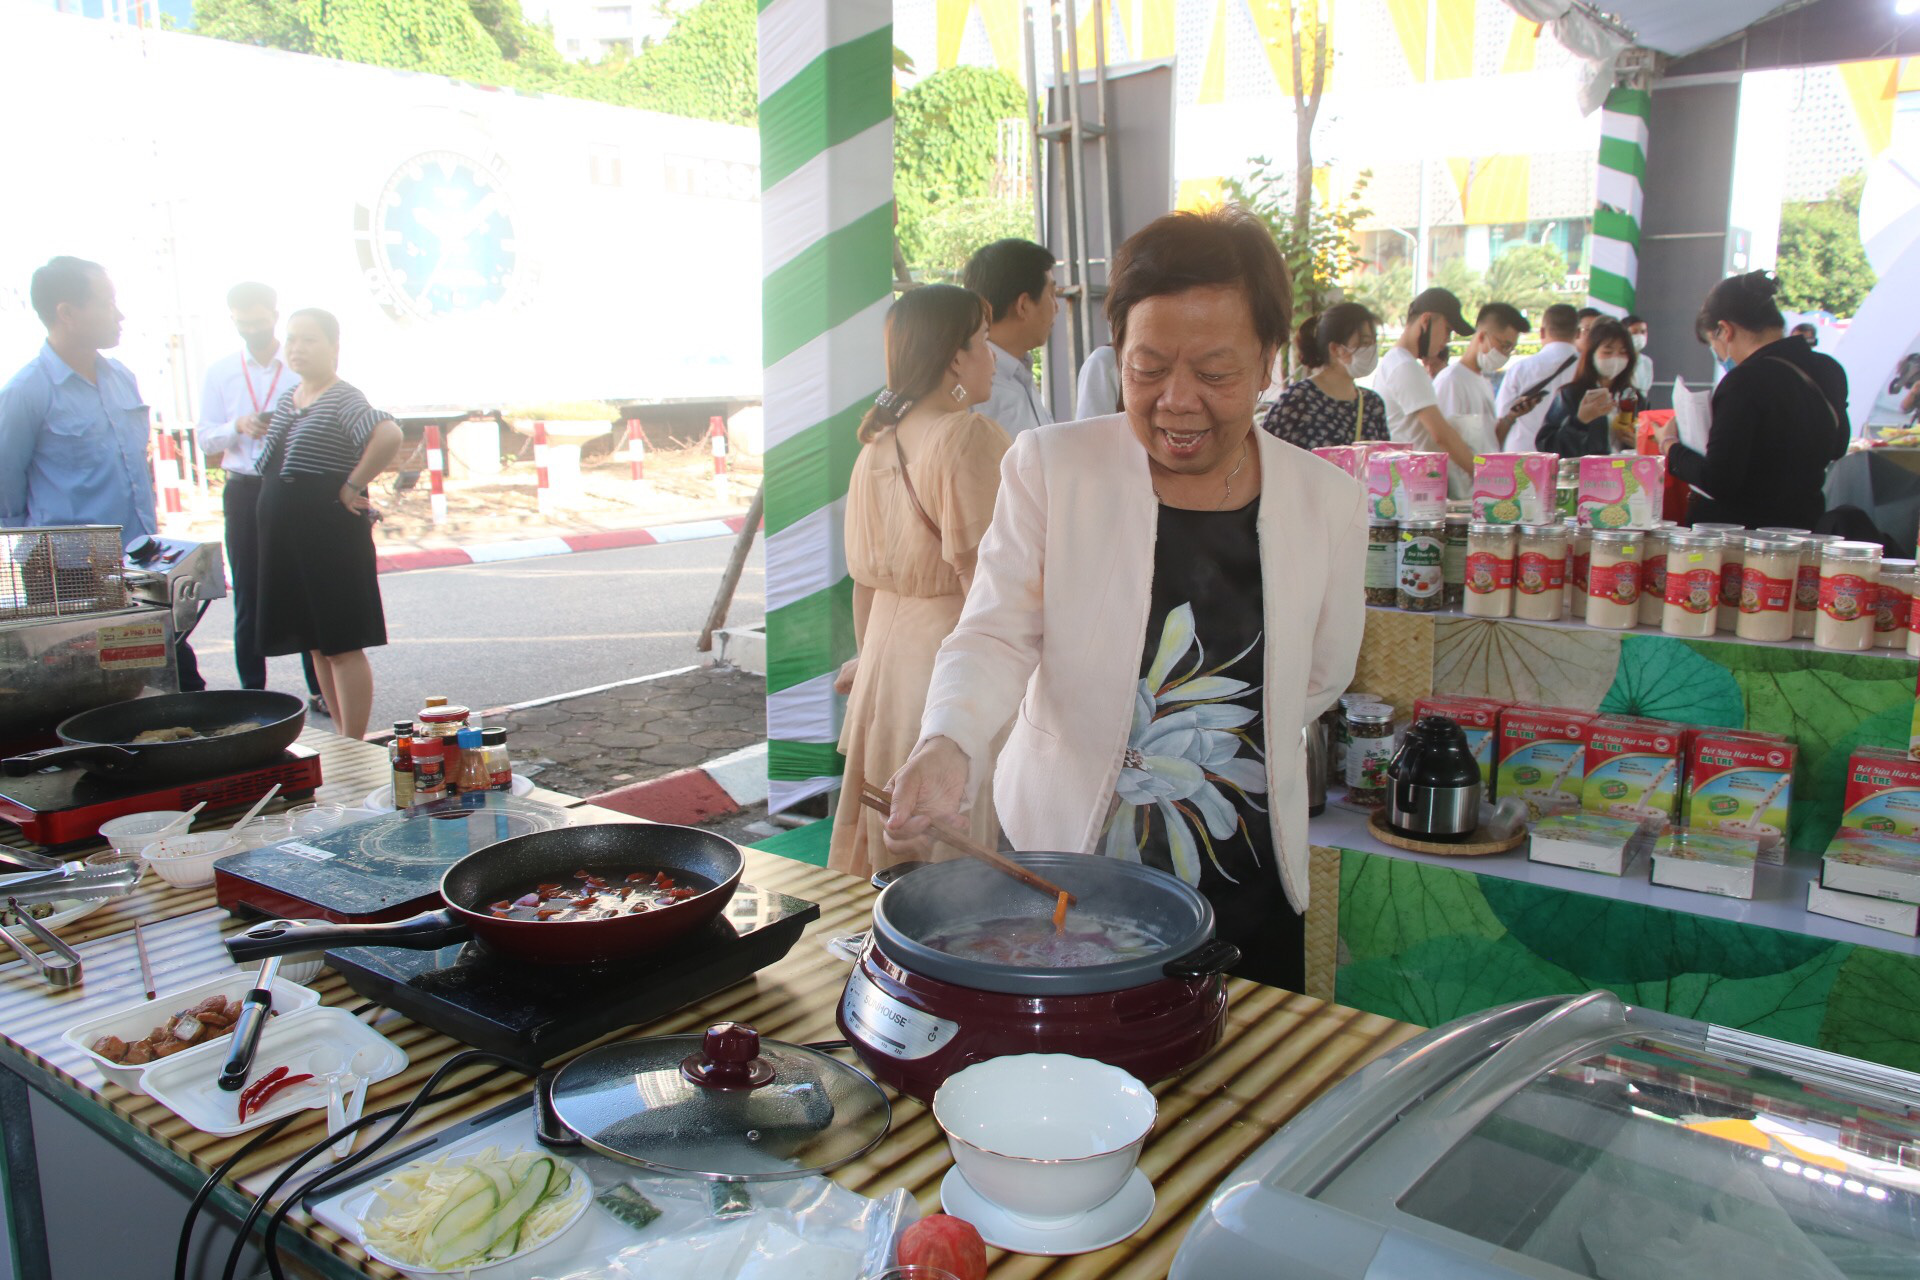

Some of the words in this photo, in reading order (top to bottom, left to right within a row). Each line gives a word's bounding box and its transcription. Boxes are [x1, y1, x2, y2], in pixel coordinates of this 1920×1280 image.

[664, 153, 760, 203] TISS
[1550, 726, 1564, 734] Sen
[1637, 739, 1652, 747] Sen
[1750, 753, 1765, 761] Sen
[1910, 772, 1920, 780] Se
[863, 994, 908, 1028] SUNHOUSE
